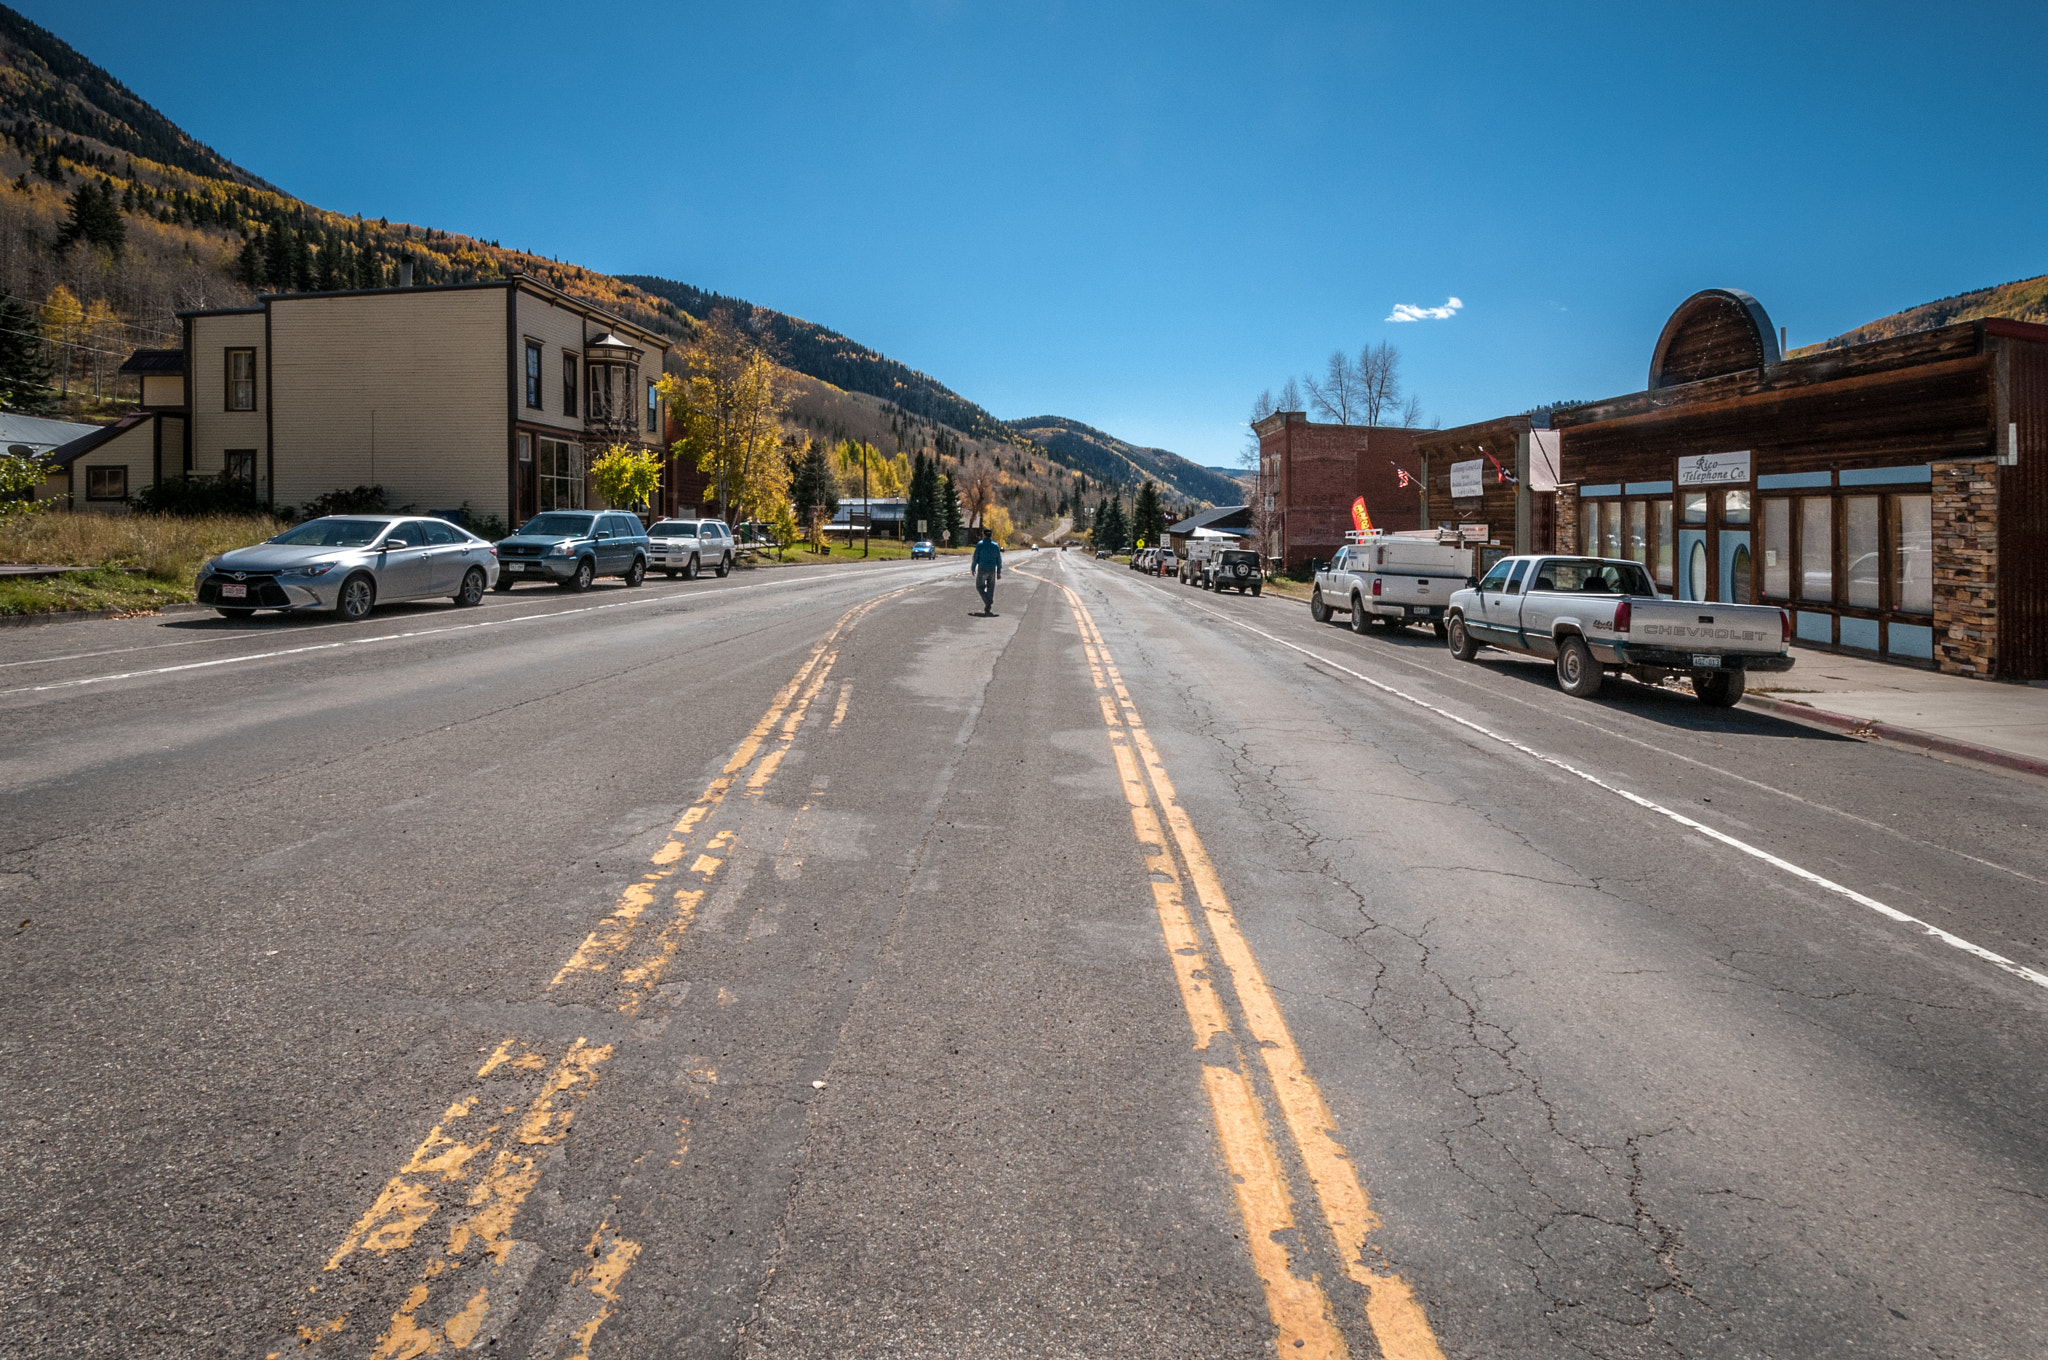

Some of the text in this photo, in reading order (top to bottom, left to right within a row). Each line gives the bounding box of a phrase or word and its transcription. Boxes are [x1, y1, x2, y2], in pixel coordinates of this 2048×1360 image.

[1696, 456, 1719, 471] Rico
[1683, 467, 1746, 483] Telephone Co.
[1644, 624, 1767, 641] CHEVROLET
